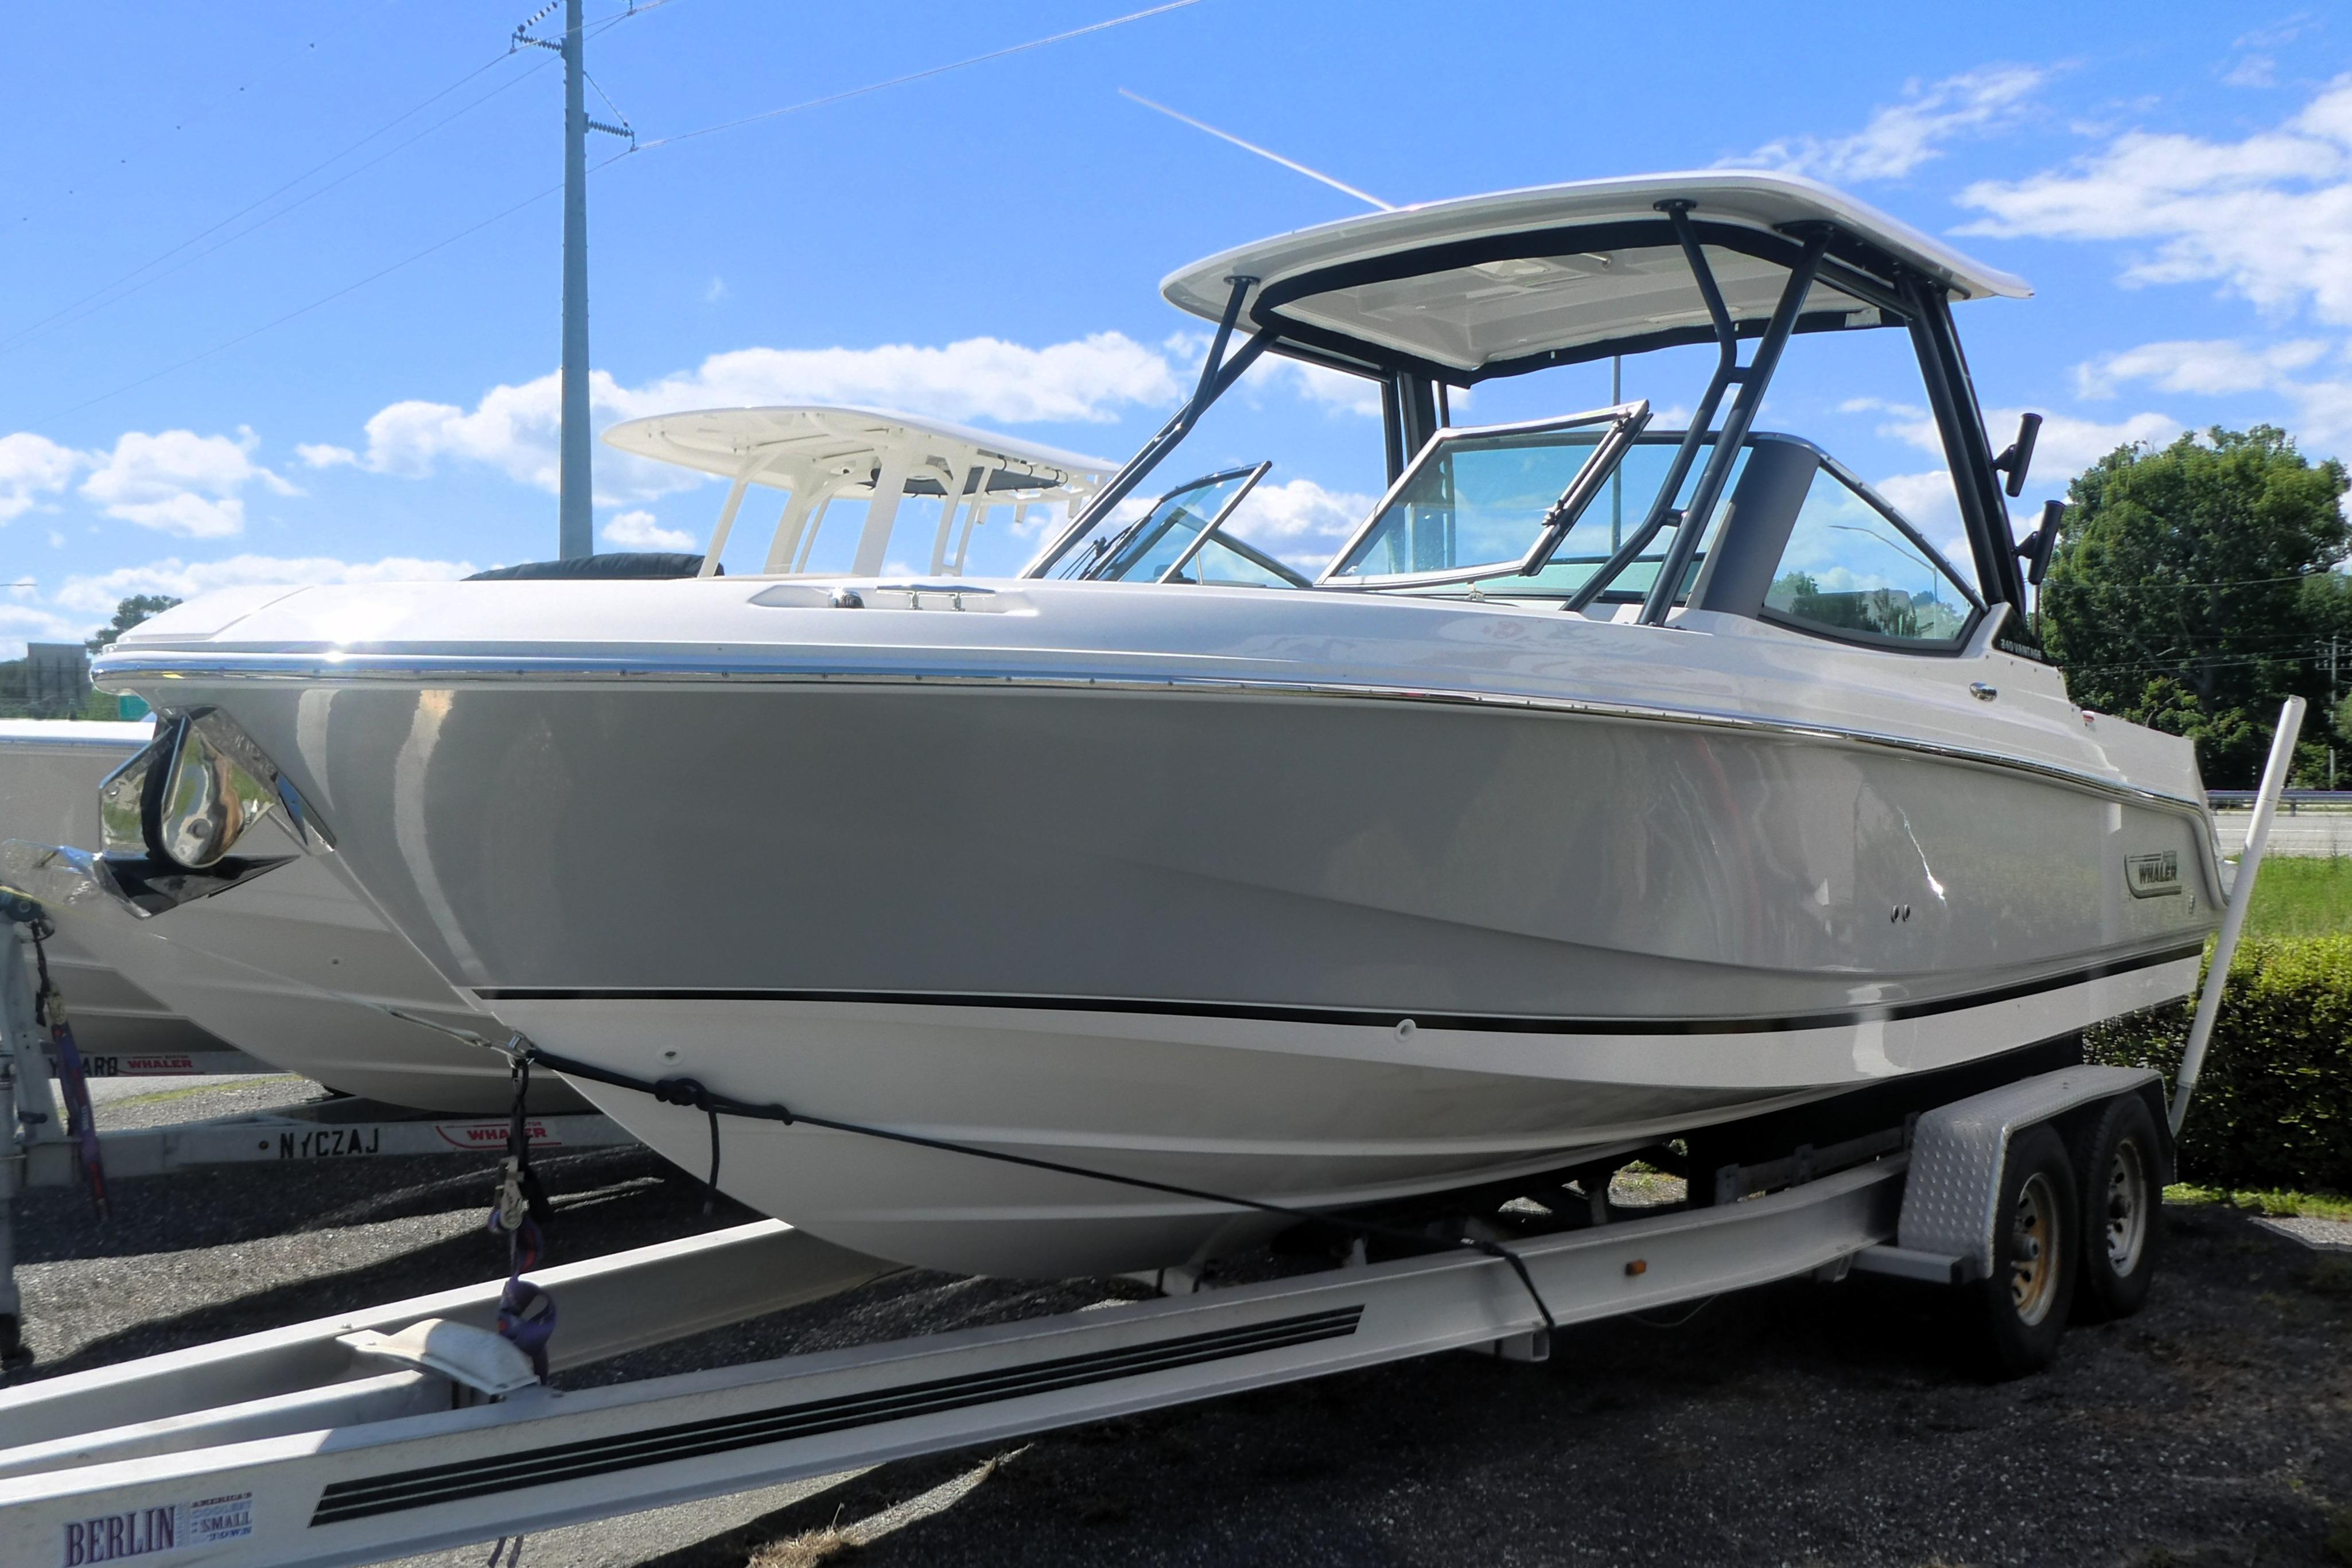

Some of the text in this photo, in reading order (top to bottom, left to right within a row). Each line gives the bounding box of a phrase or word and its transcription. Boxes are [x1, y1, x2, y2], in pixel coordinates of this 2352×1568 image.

[2139, 862, 2177, 884] WHALER
[127, 1060, 193, 1068] WHALER
[466, 1127, 548, 1141] WHAER
[200, 1511, 252, 1534] SMALL
[62, 1505, 176, 1568] BERLIN
[208, 1526, 252, 1542] TOWN
